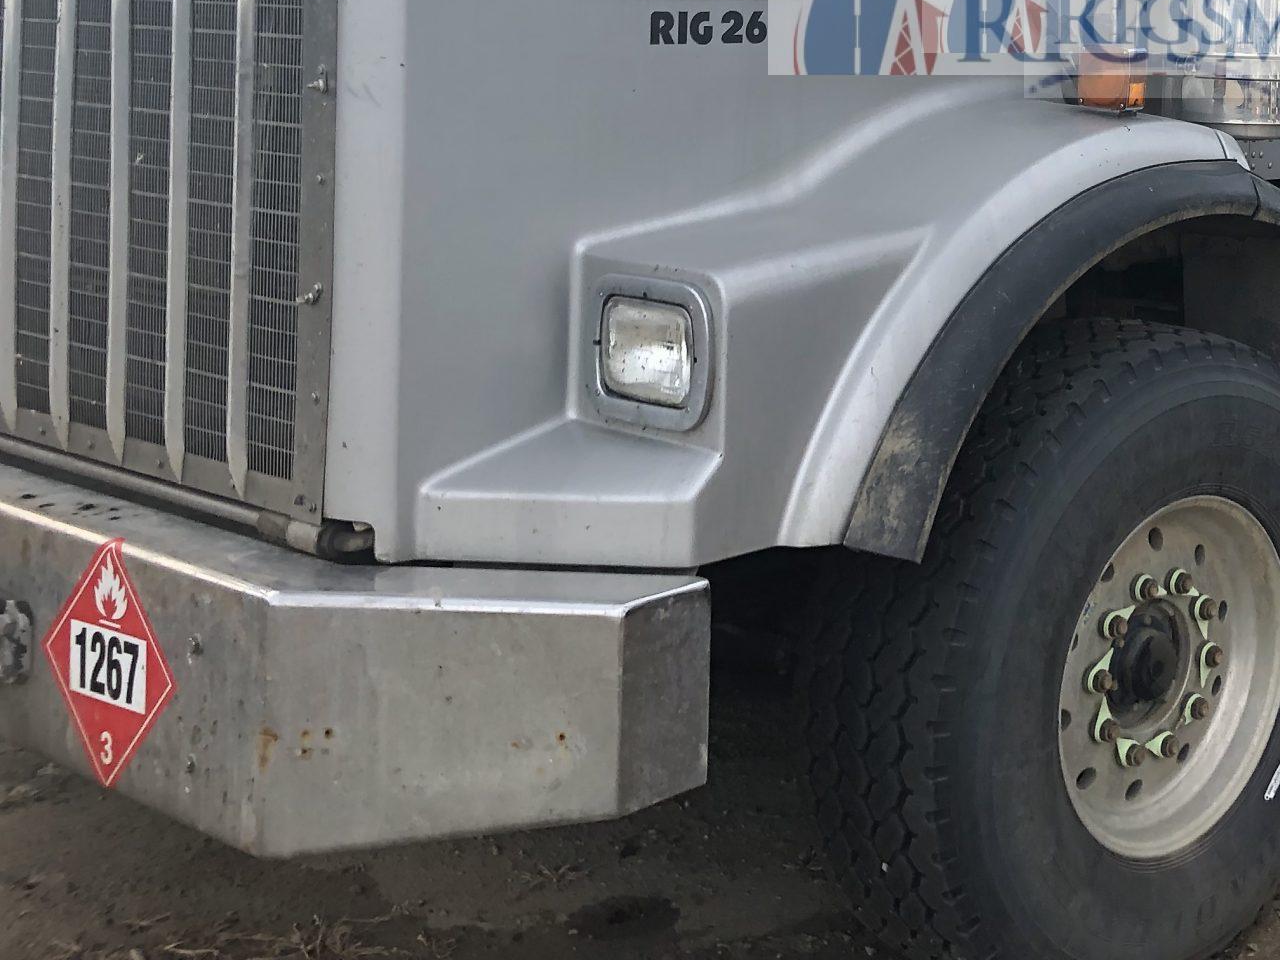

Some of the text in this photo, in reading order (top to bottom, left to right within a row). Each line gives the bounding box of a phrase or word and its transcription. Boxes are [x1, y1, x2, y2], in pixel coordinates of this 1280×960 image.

[650, 10, 768, 45] RIG 26
[75, 627, 140, 705] 1267
[100, 731, 113, 765] 3
